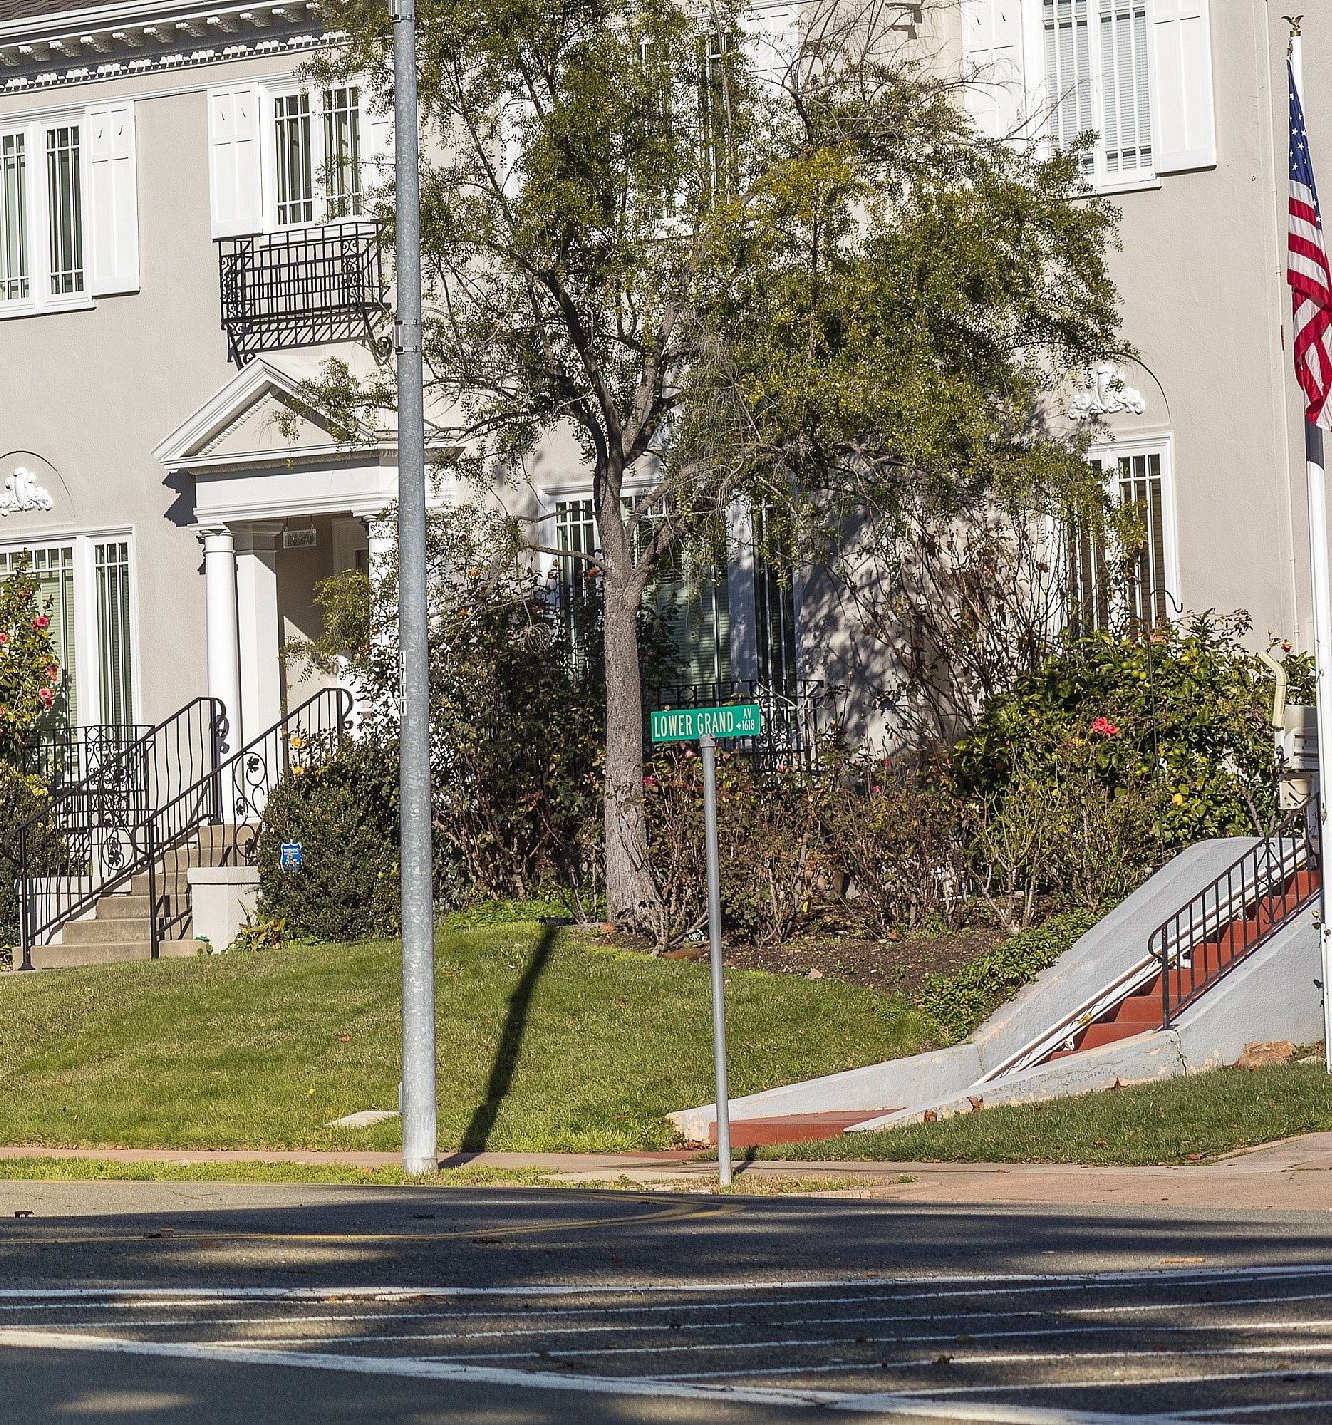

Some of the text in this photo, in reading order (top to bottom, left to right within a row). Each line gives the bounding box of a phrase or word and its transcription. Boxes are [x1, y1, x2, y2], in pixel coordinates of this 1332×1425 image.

[654, 708, 752, 737] LOWER GRAND AV
[742, 719, 755, 731] 1618
